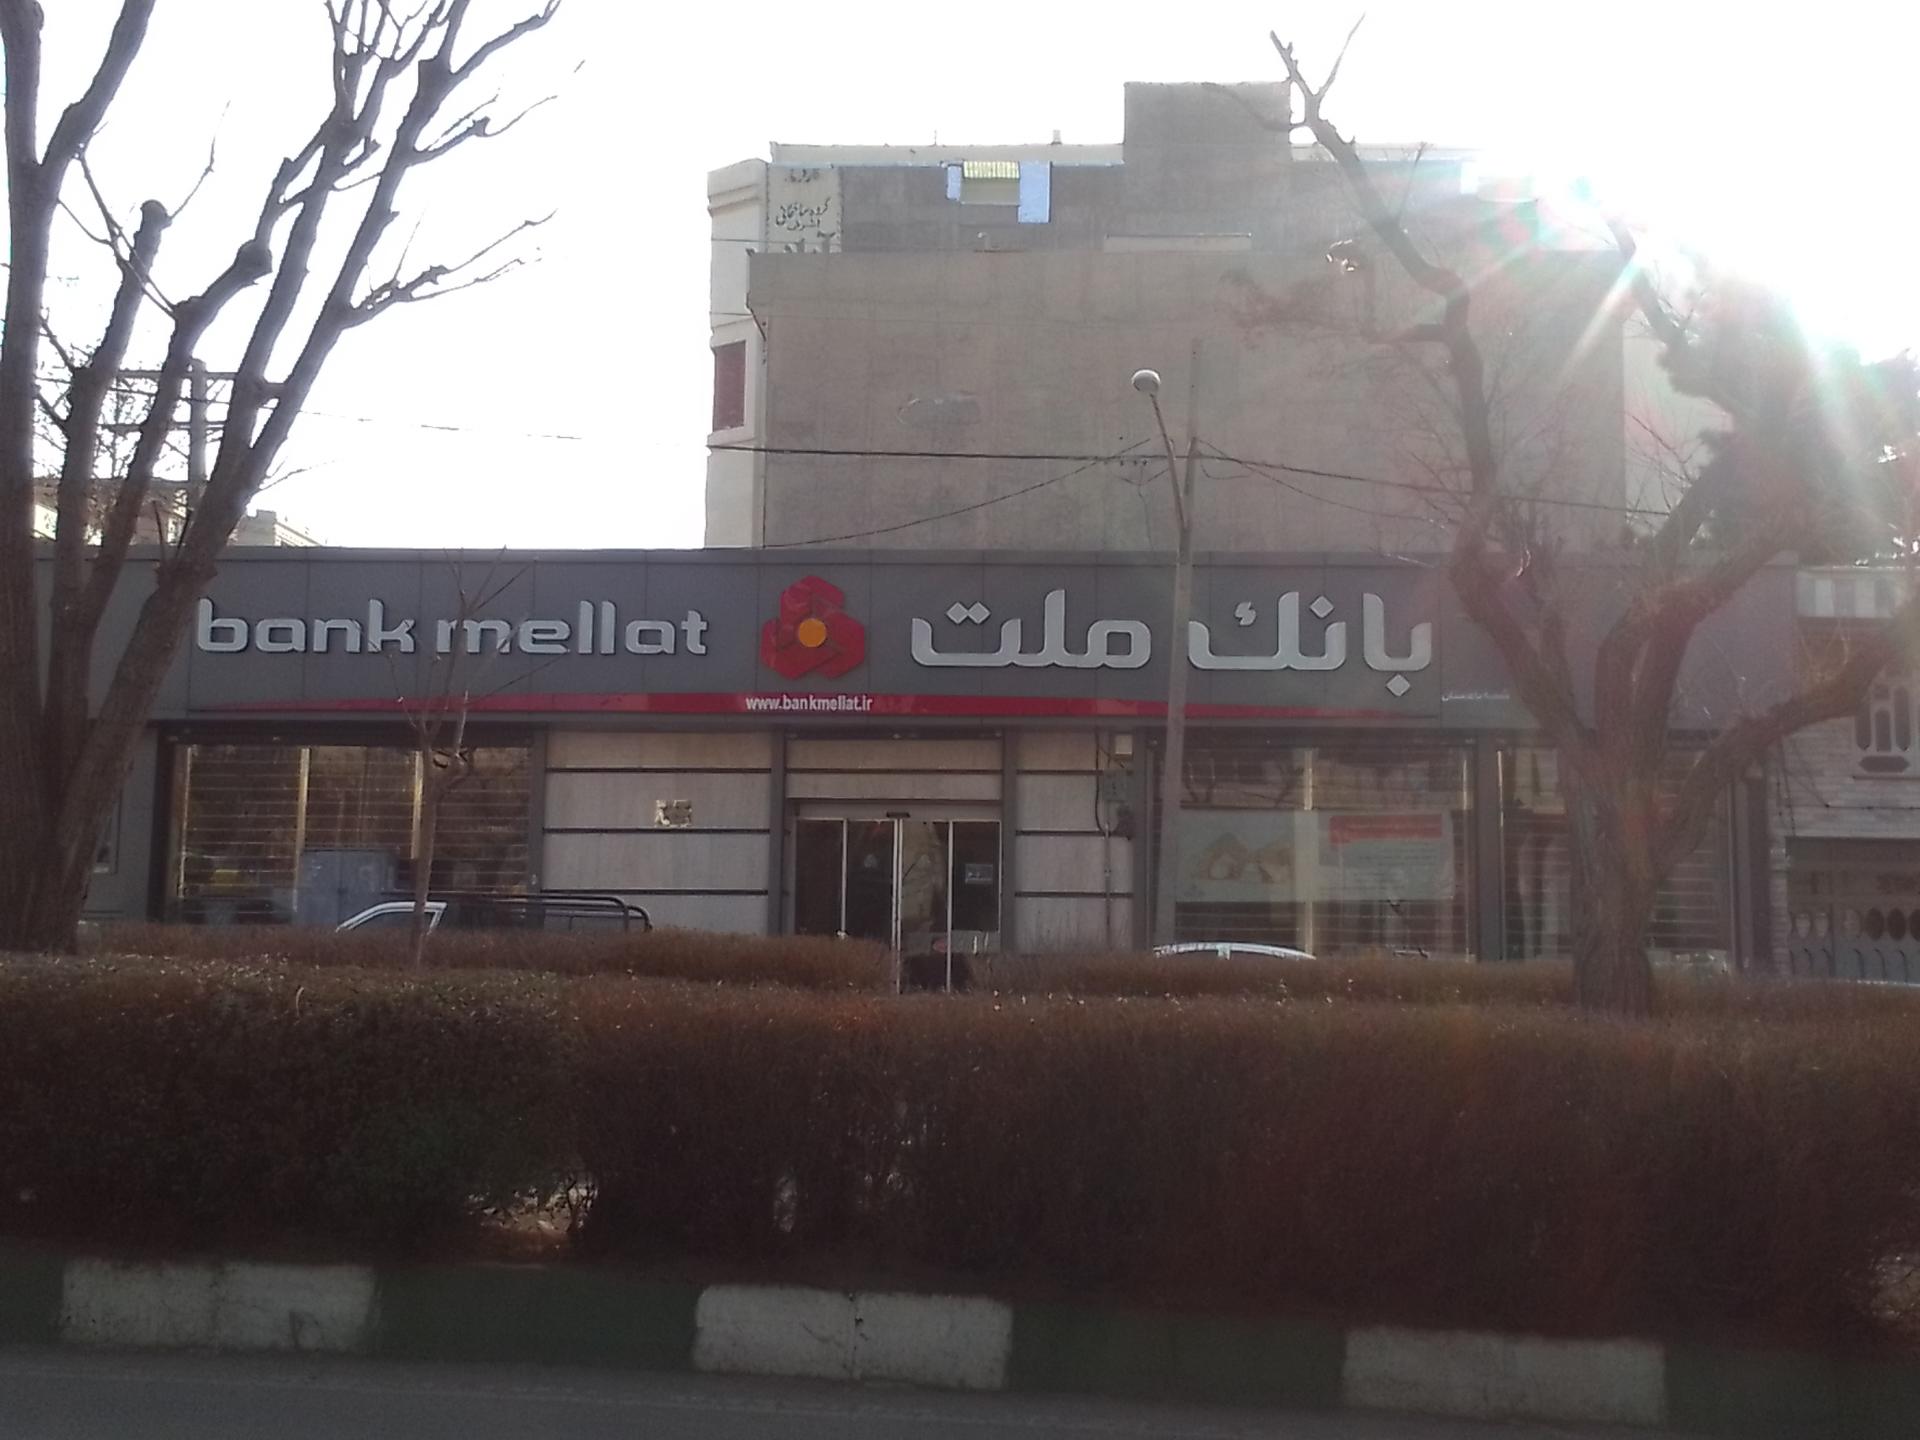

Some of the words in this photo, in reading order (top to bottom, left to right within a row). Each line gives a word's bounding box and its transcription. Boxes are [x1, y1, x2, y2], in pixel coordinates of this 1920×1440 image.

[198, 599, 415, 654] bank
[434, 600, 709, 655] mellat
[912, 589, 1151, 669] ملت
[745, 694, 873, 711] www.bankmellat.ir
